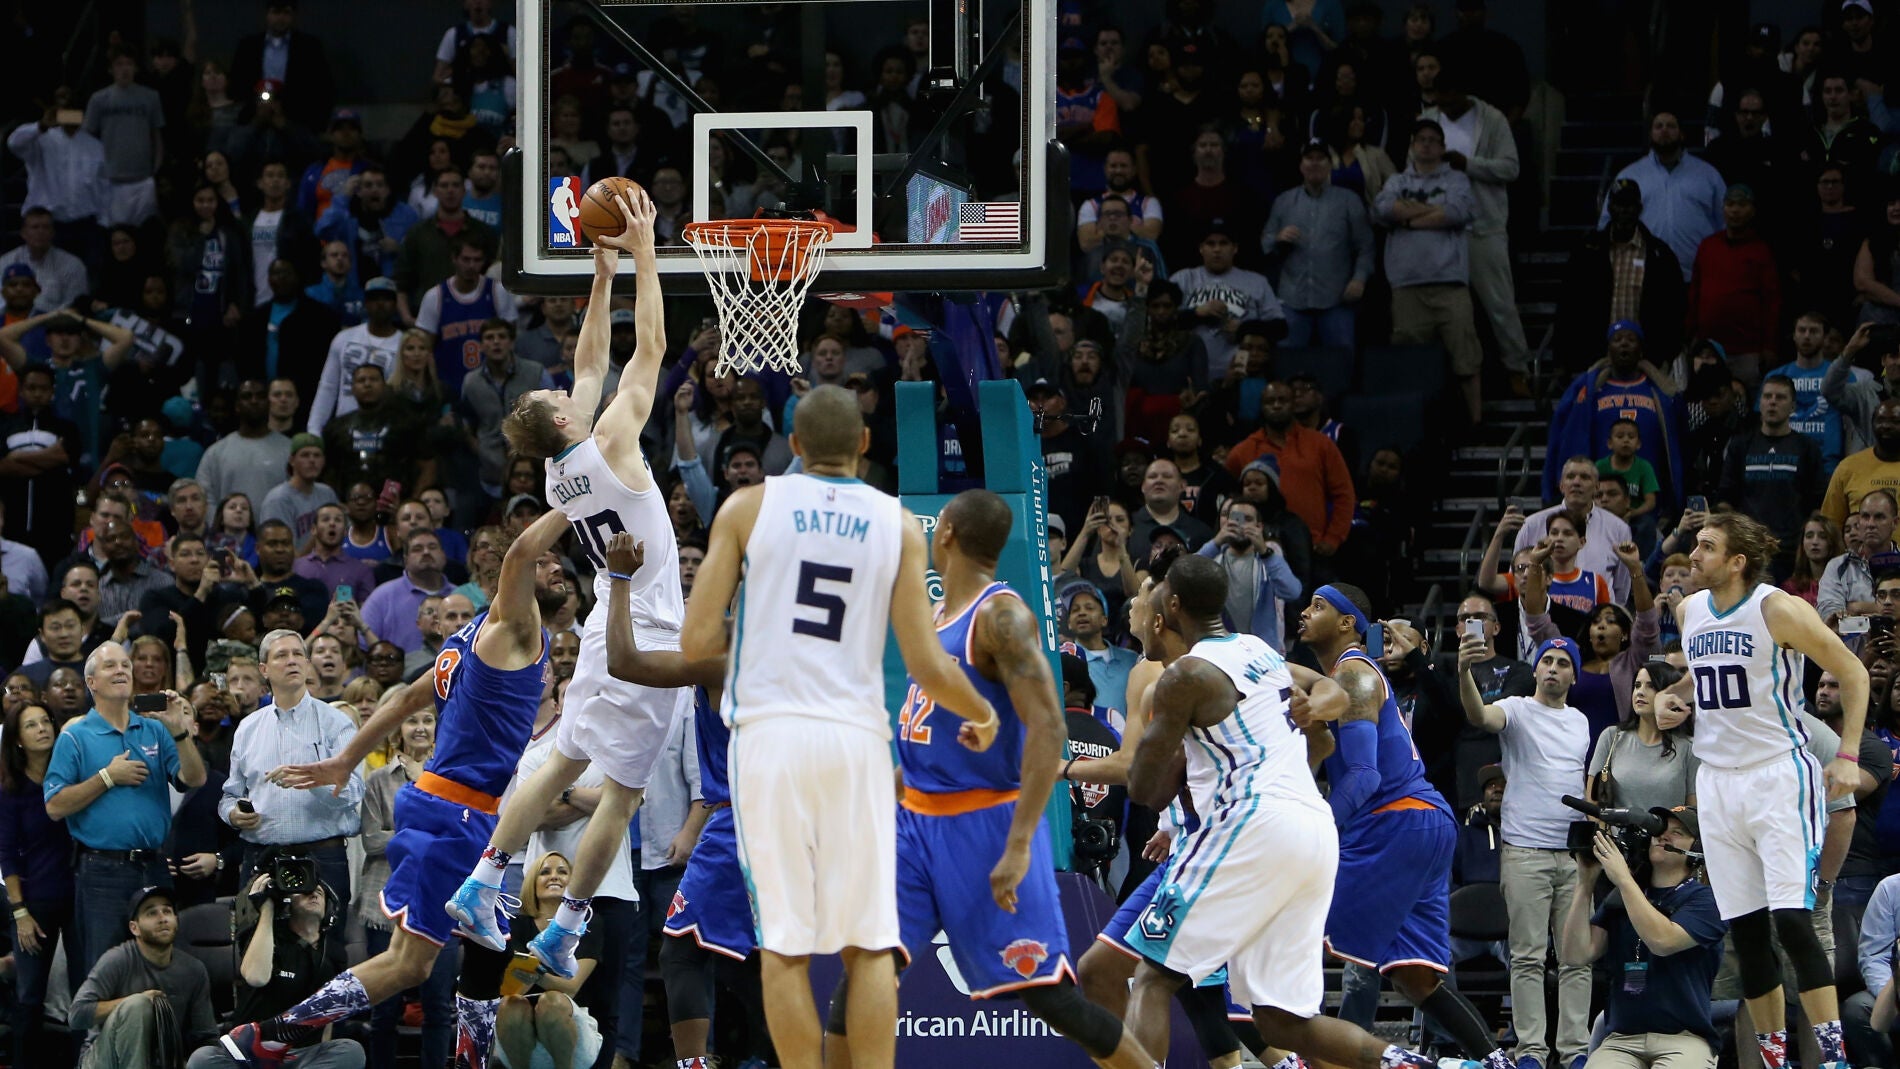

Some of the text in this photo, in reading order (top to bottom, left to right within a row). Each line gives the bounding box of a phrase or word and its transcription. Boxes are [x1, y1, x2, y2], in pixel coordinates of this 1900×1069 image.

[553, 233, 572, 243] NBA
[463, 339, 481, 369] 8
[552, 475, 593, 505] ZELLER
[793, 509, 871, 543] BATUM
[1031, 461, 1047, 562] SECURITY
[792, 560, 853, 643] 5
[1688, 631, 1756, 661] HORNETS
[433, 648, 462, 701] 8
[1694, 665, 1752, 711] 00
[898, 683, 935, 745] 42
[1069, 739, 1113, 758] SECURITY
